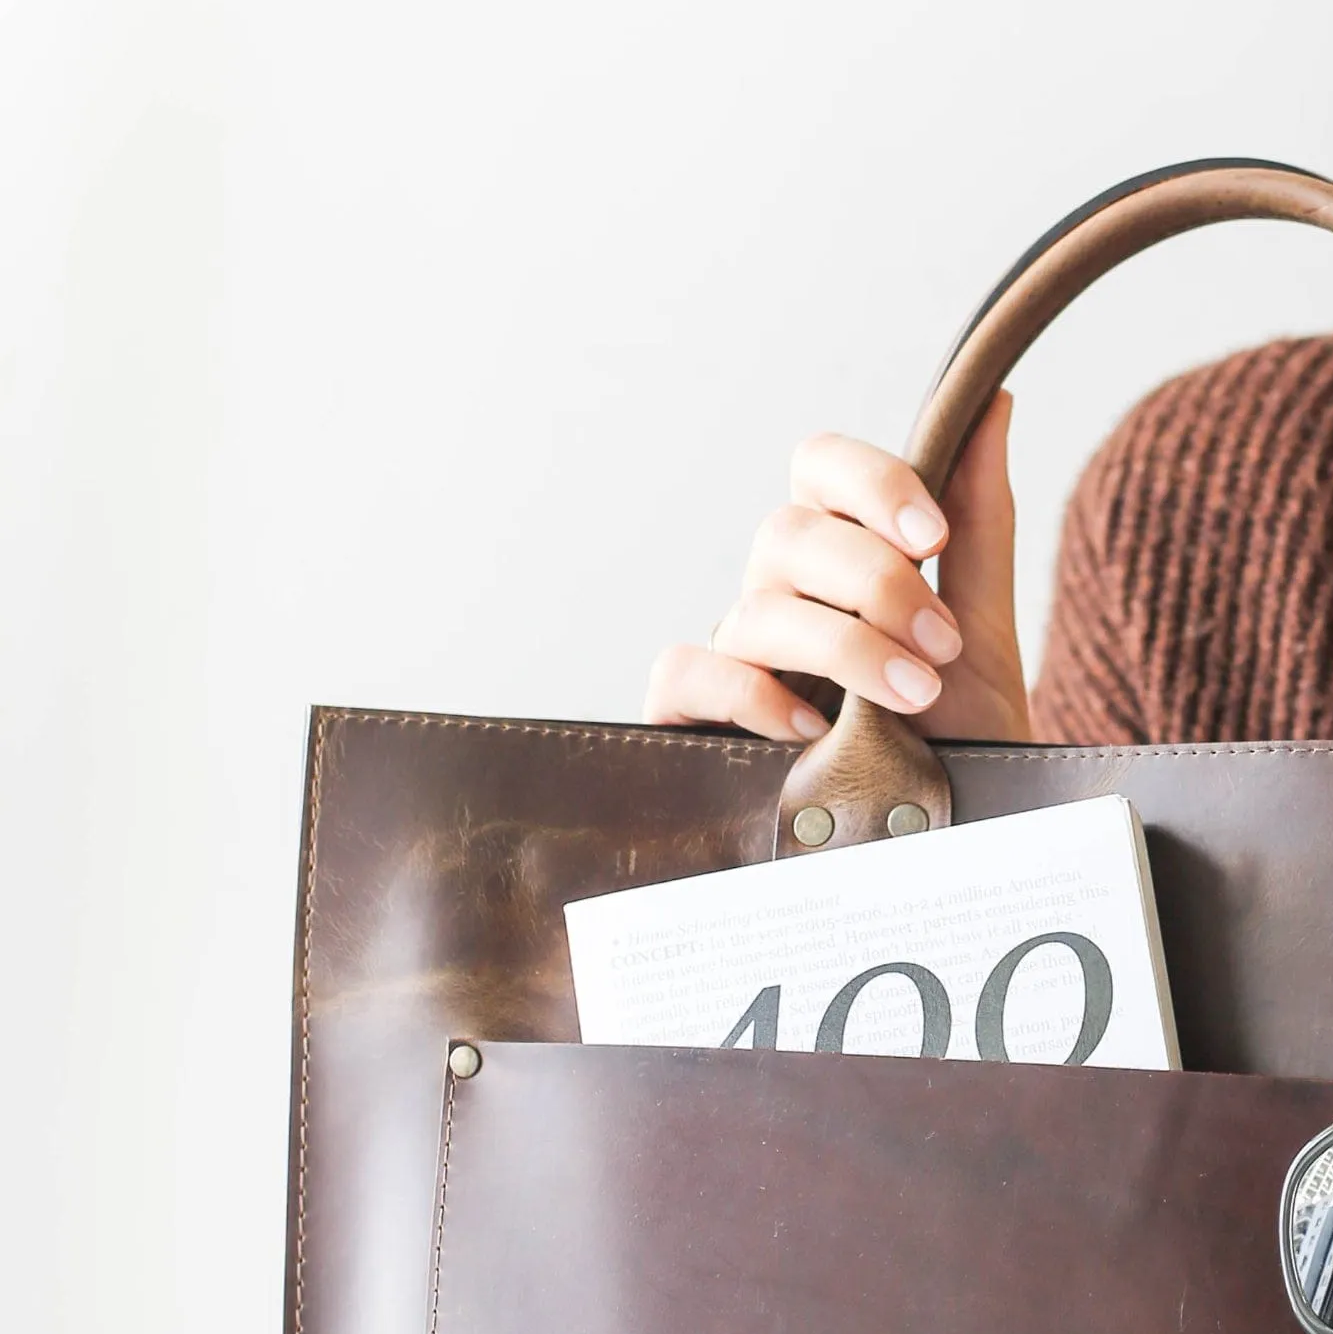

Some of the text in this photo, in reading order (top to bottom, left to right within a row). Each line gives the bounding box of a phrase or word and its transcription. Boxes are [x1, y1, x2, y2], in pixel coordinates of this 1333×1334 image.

[608, 938, 704, 969] CONCEPT:
[729, 930, 755, 946] the
[757, 925, 792, 946] year
[947, 885, 1003, 905] million
[1006, 870, 1082, 894] American
[626, 893, 841, 946] Home Schooling Consultant
[680, 960, 717, 976] were
[922, 908, 981, 935] parents
[984, 891, 1077, 919] considering
[1078, 884, 1109, 901] this
[615, 990, 664, 1011] option
[668, 984, 692, 999] for
[694, 976, 730, 994] their
[734, 965, 797, 986] children
[803, 951, 857, 973] usually
[860, 942, 899, 963] don't
[905, 936, 946, 954] know
[951, 929, 981, 945] how
[1001, 918, 1021, 936] all
[1025, 910, 1072, 932] works
[867, 973, 953, 1001] Consunt
[957, 970, 984, 985] can
[618, 1004, 690, 1030] pecially
[695, 1001, 710, 1014] in
[864, 998, 918, 1026] spinoff
[1031, 976, 1058, 991] see
[868, 1025, 904, 1042] more
